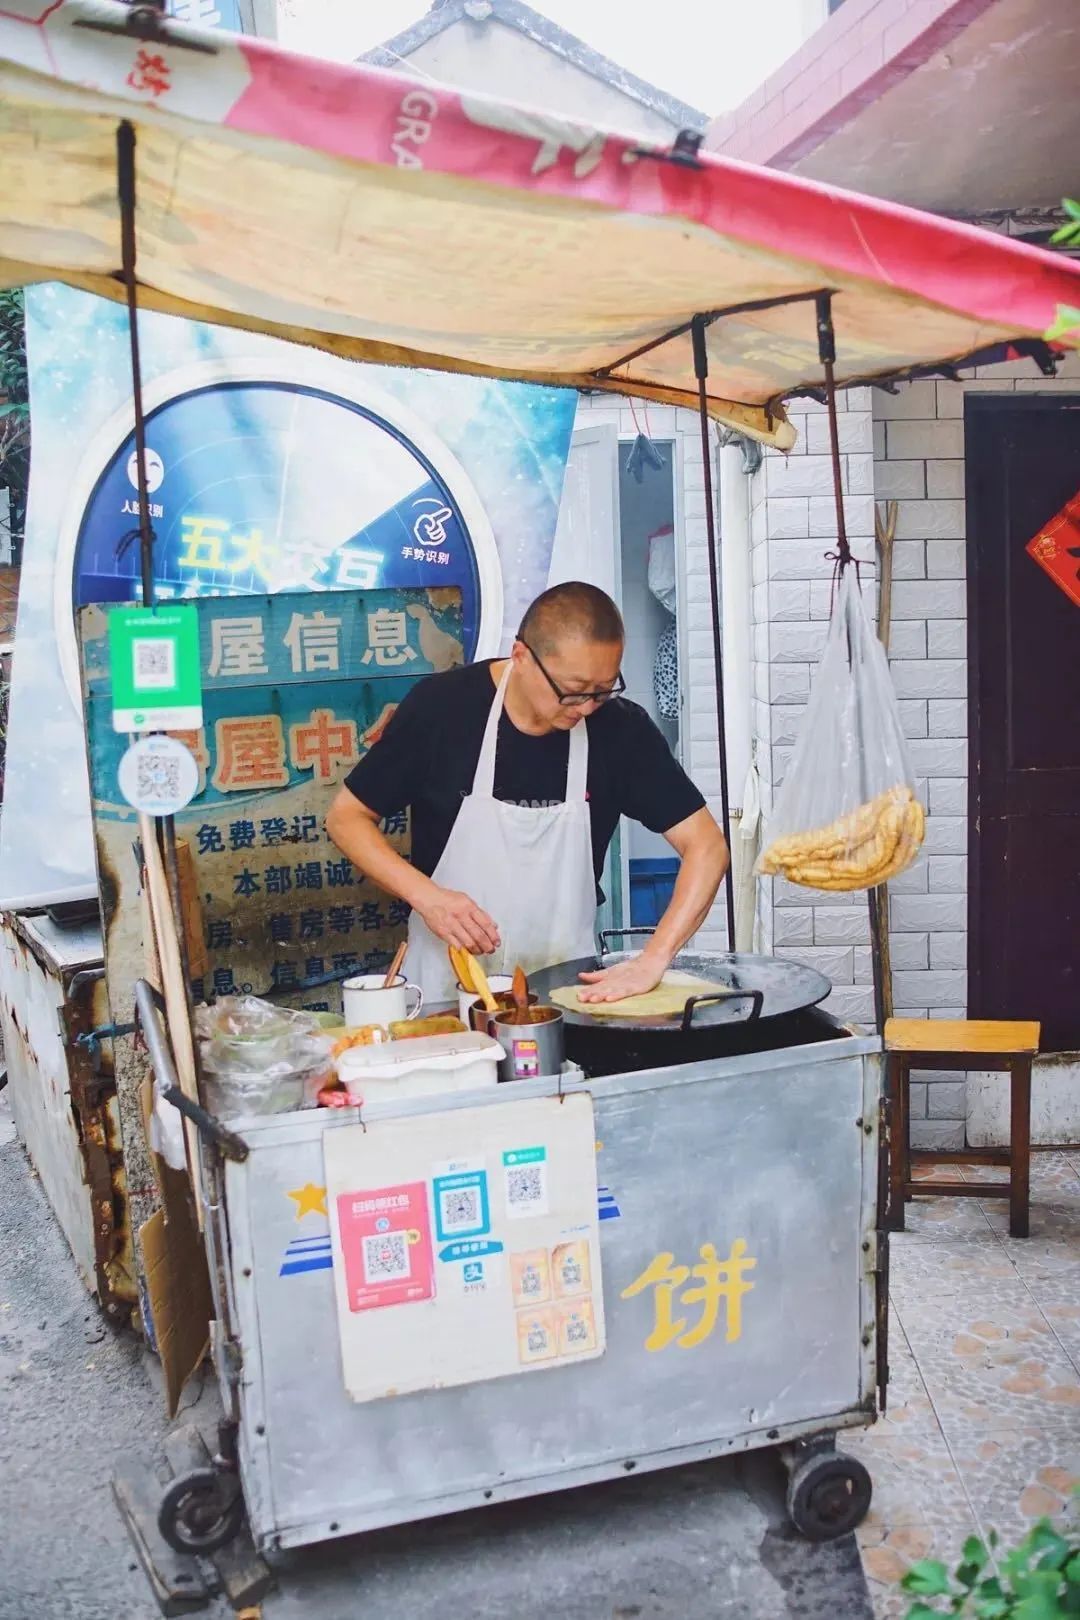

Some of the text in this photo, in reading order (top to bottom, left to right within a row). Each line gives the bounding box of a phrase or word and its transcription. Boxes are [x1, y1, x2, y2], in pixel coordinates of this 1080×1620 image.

[178, 516, 385, 594] 五大交互
[401, 546, 449, 565] 手势识别
[207, 608, 418, 677] 屋信息
[233, 857, 364, 898] 本部竭诚
[619, 1238, 757, 1351] 饼
